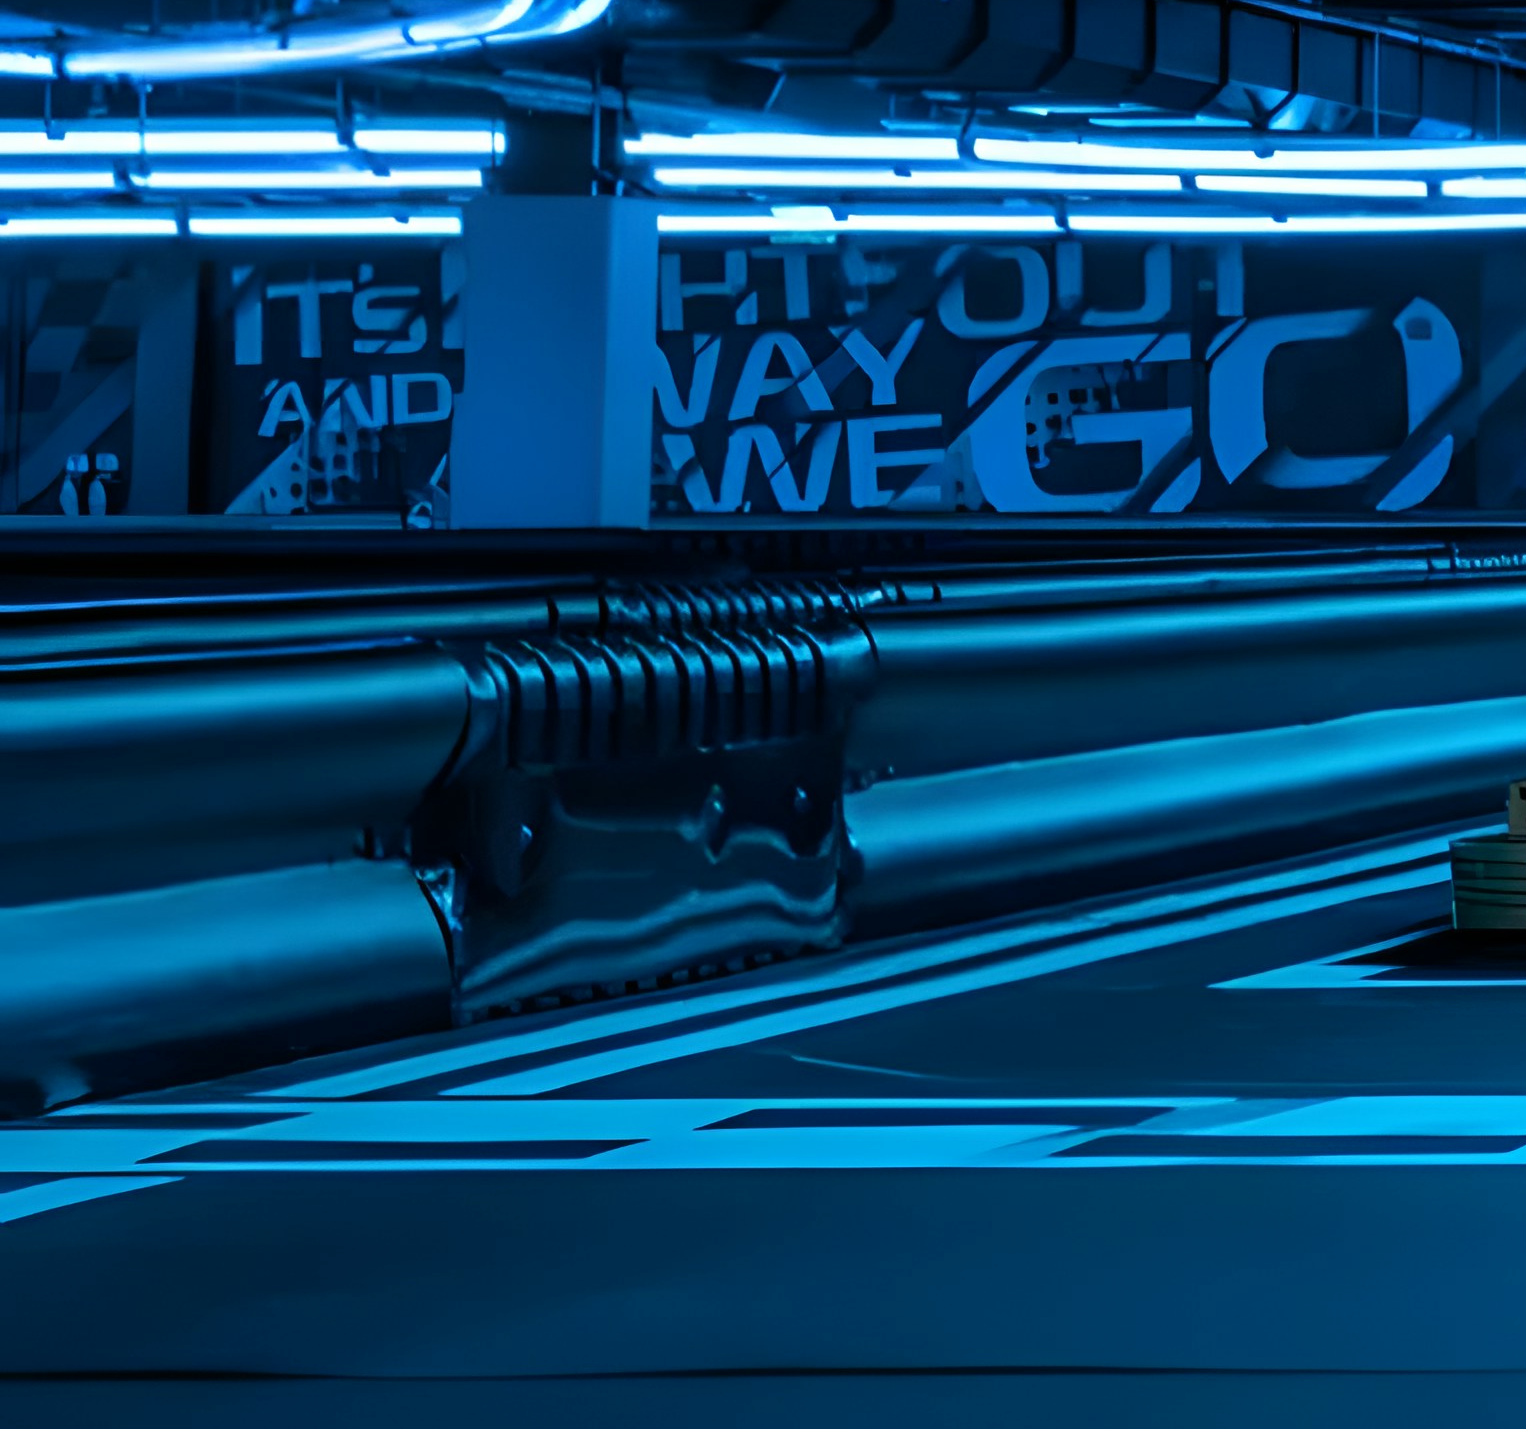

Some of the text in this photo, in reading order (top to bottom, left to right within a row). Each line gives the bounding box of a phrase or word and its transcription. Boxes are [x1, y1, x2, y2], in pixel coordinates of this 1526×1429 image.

[231, 262, 428, 366] IT'S
[257, 317, 926, 438] AND WAY
[662, 295, 1463, 513] WE GO
